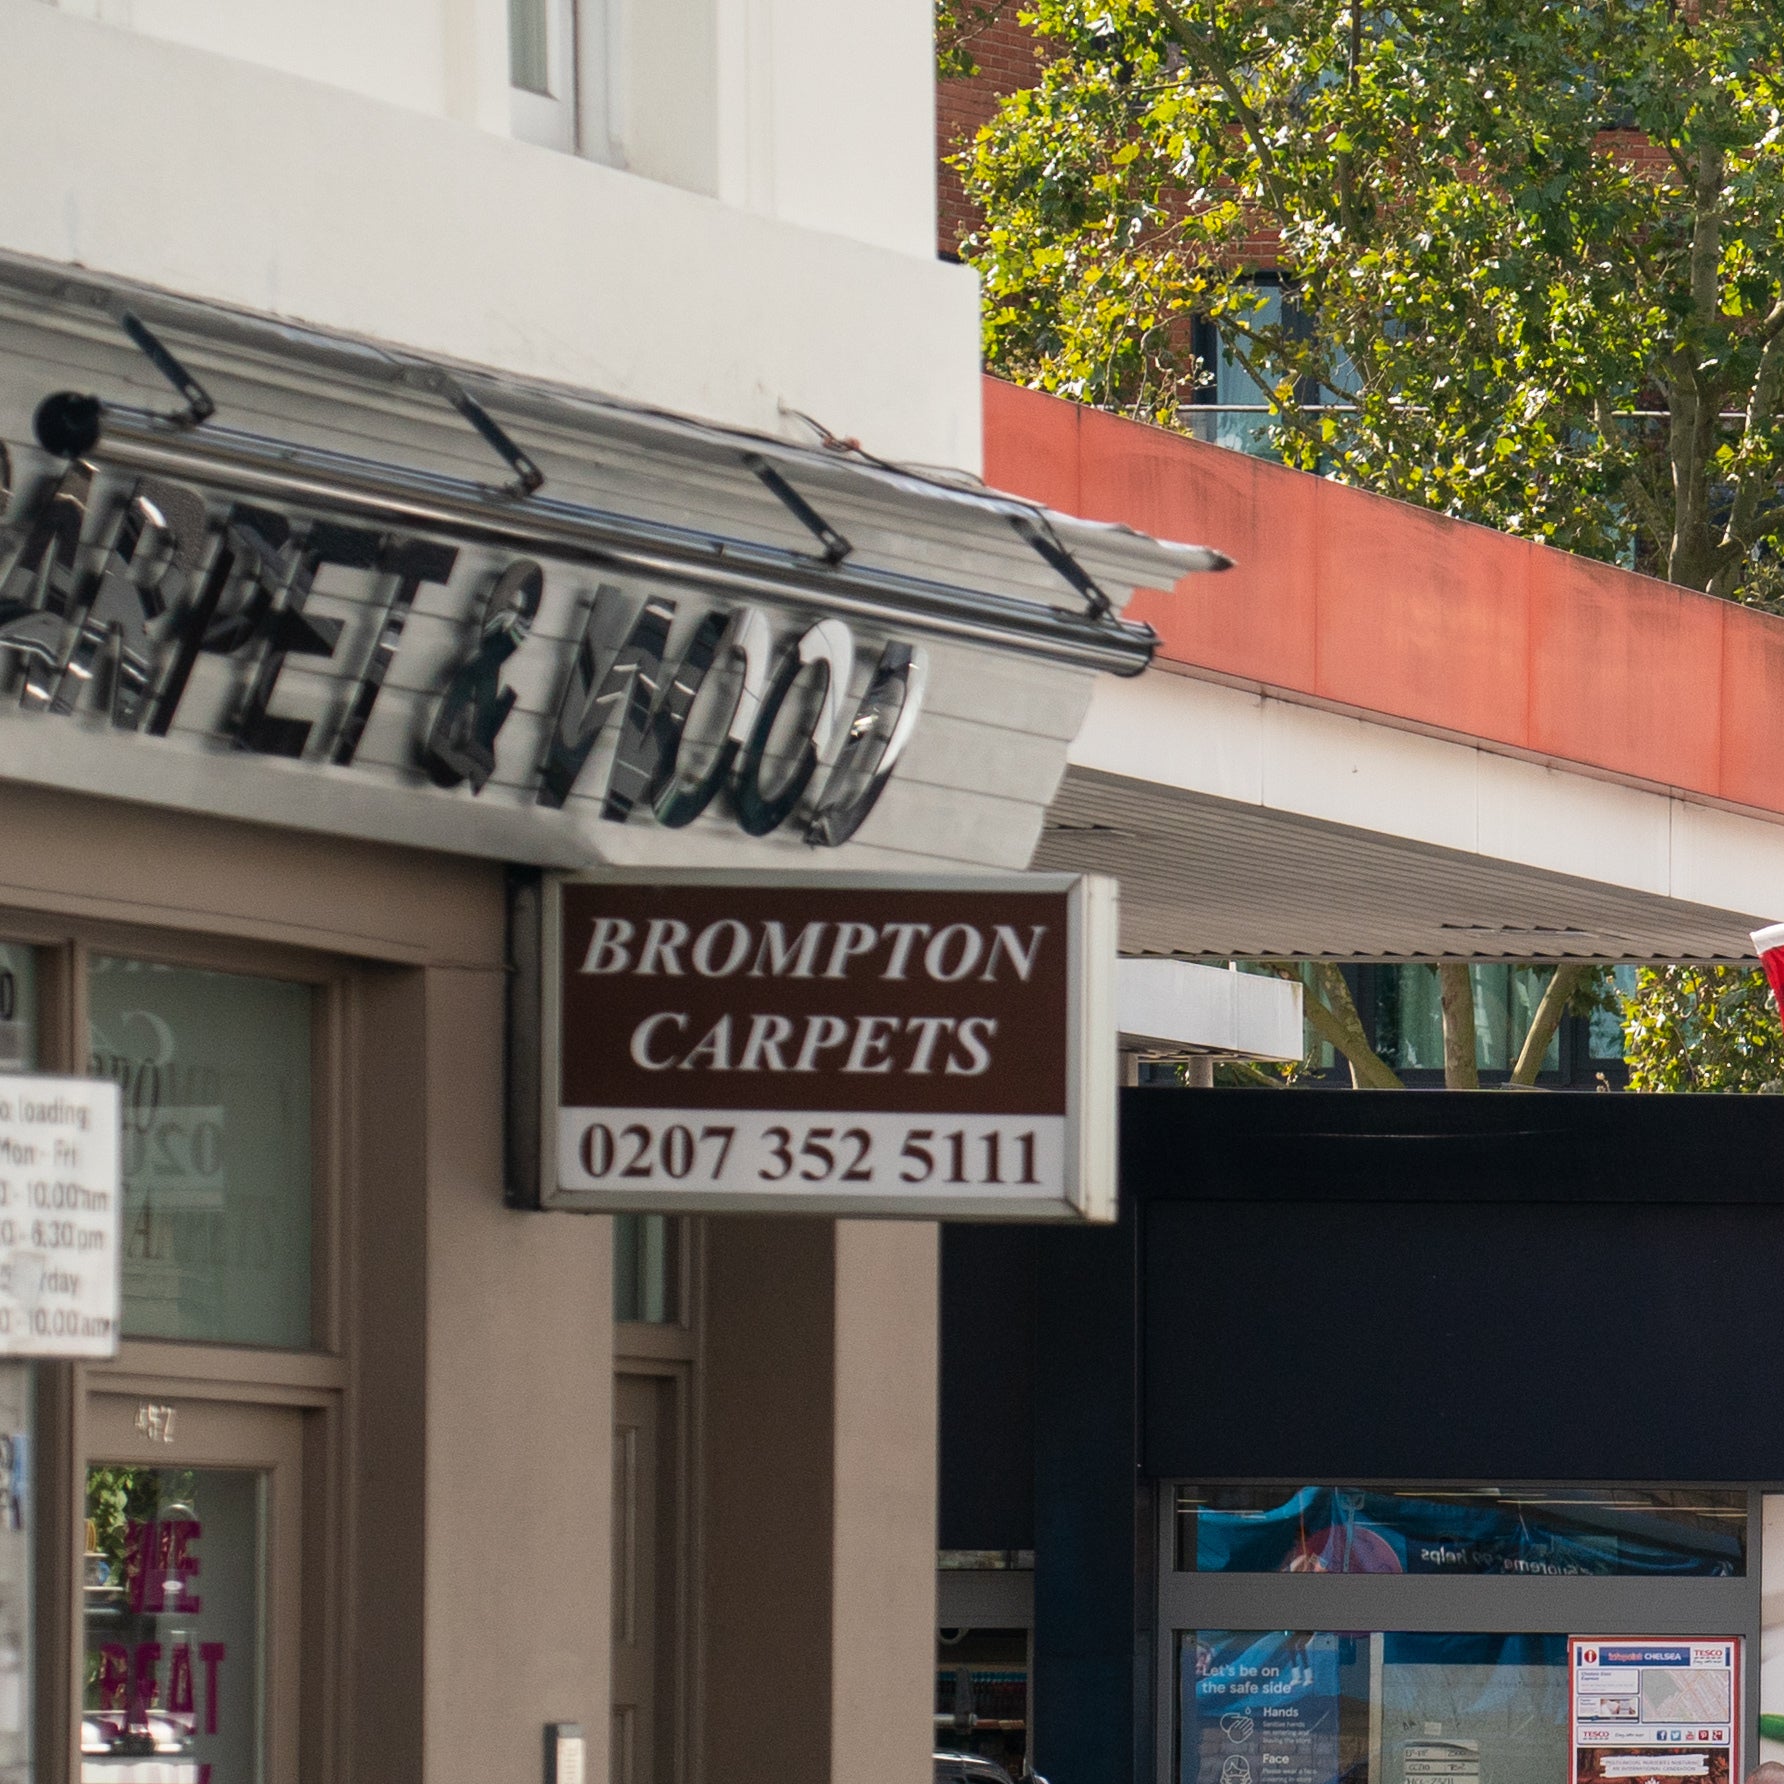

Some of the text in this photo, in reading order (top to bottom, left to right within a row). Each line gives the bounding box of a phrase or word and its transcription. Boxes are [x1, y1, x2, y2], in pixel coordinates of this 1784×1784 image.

[0, 438, 460, 767] ARPET
[579, 917, 1048, 986] BROMPTON
[627, 1014, 998, 1077] CARPETS
[579, 1122, 1047, 1187] 0207 352 5111
[1202, 1681, 1292, 1694] the safe side
[1203, 1664, 1280, 1677] Let's be on
[1263, 1706, 1299, 1718] Hands
[1262, 1753, 1290, 1764] Face
